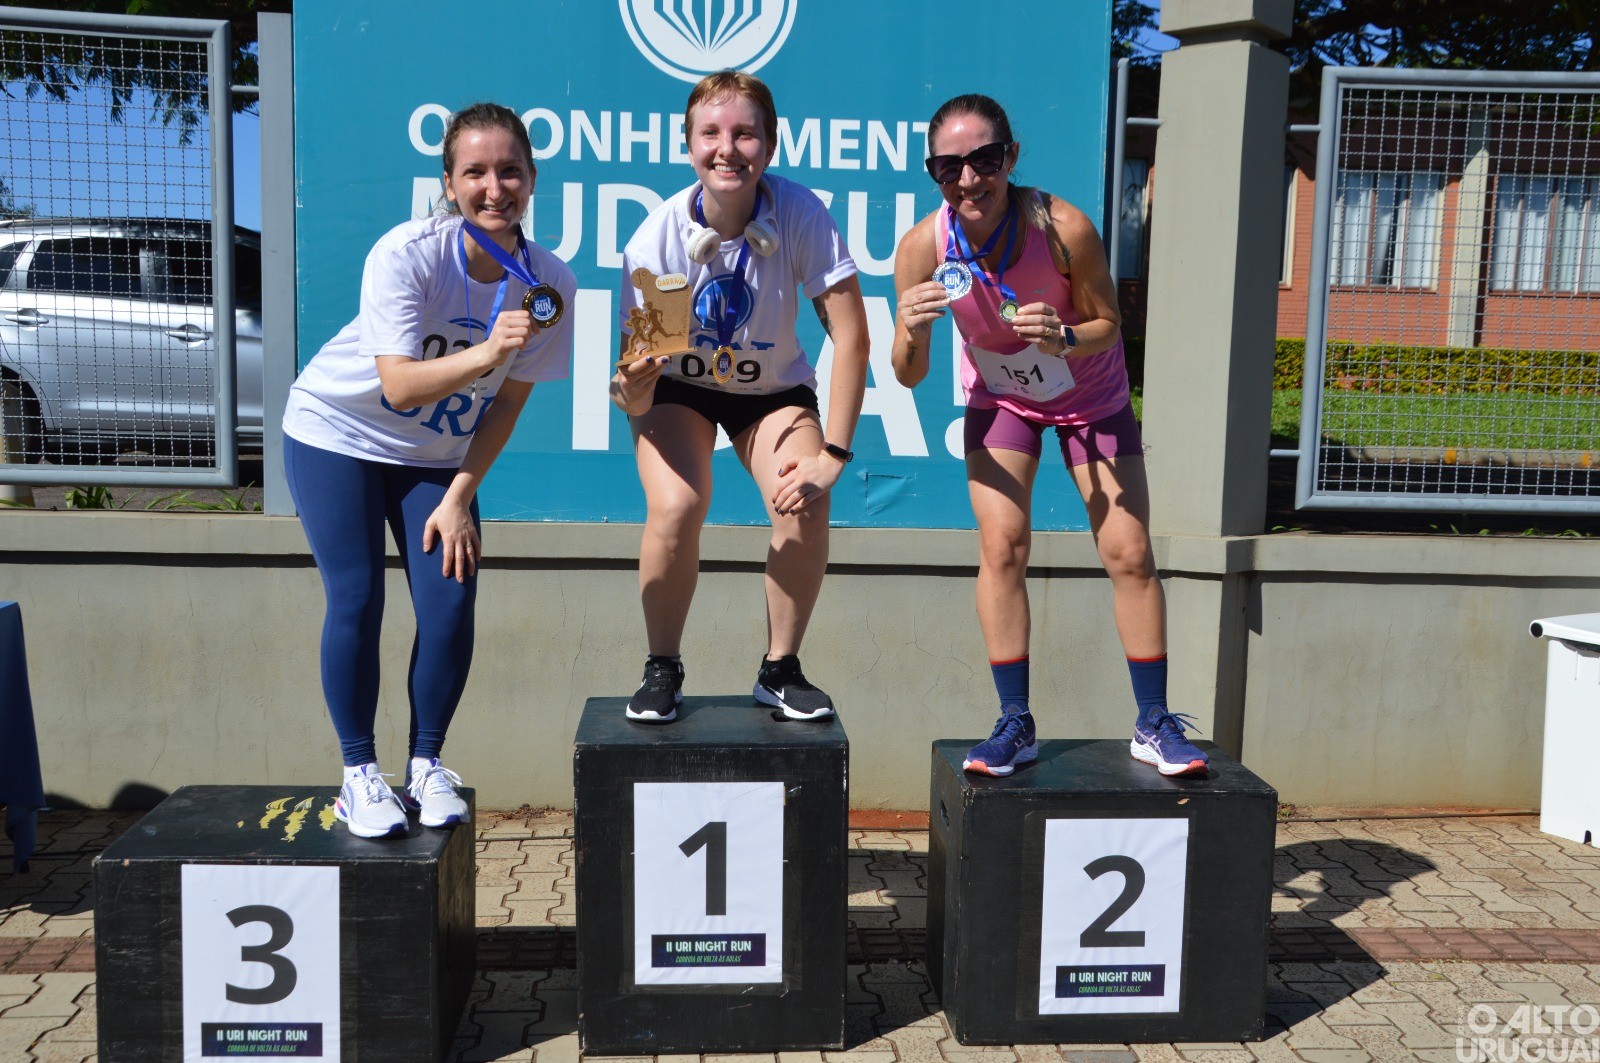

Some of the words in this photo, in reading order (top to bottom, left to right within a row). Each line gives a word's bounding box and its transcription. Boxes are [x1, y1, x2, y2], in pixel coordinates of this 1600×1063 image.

[944, 272, 960, 287] RUN
[535, 297, 551, 313] RUN
[681, 354, 761, 383] 09
[1001, 364, 1044, 385] 151
[678, 821, 727, 915] 1
[1080, 855, 1145, 948] 2
[225, 904, 298, 1005] 3
[675, 941, 692, 952] URI
[694, 941, 727, 952] NIGHT
[730, 940, 752, 951] RUN
[1078, 972, 1095, 983] URI
[1097, 971, 1129, 983] NIGHT
[1131, 971, 1152, 982] RUN
[226, 1029, 244, 1042] URI
[247, 1029, 282, 1042] NIGHT
[285, 1029, 308, 1042] RUN
